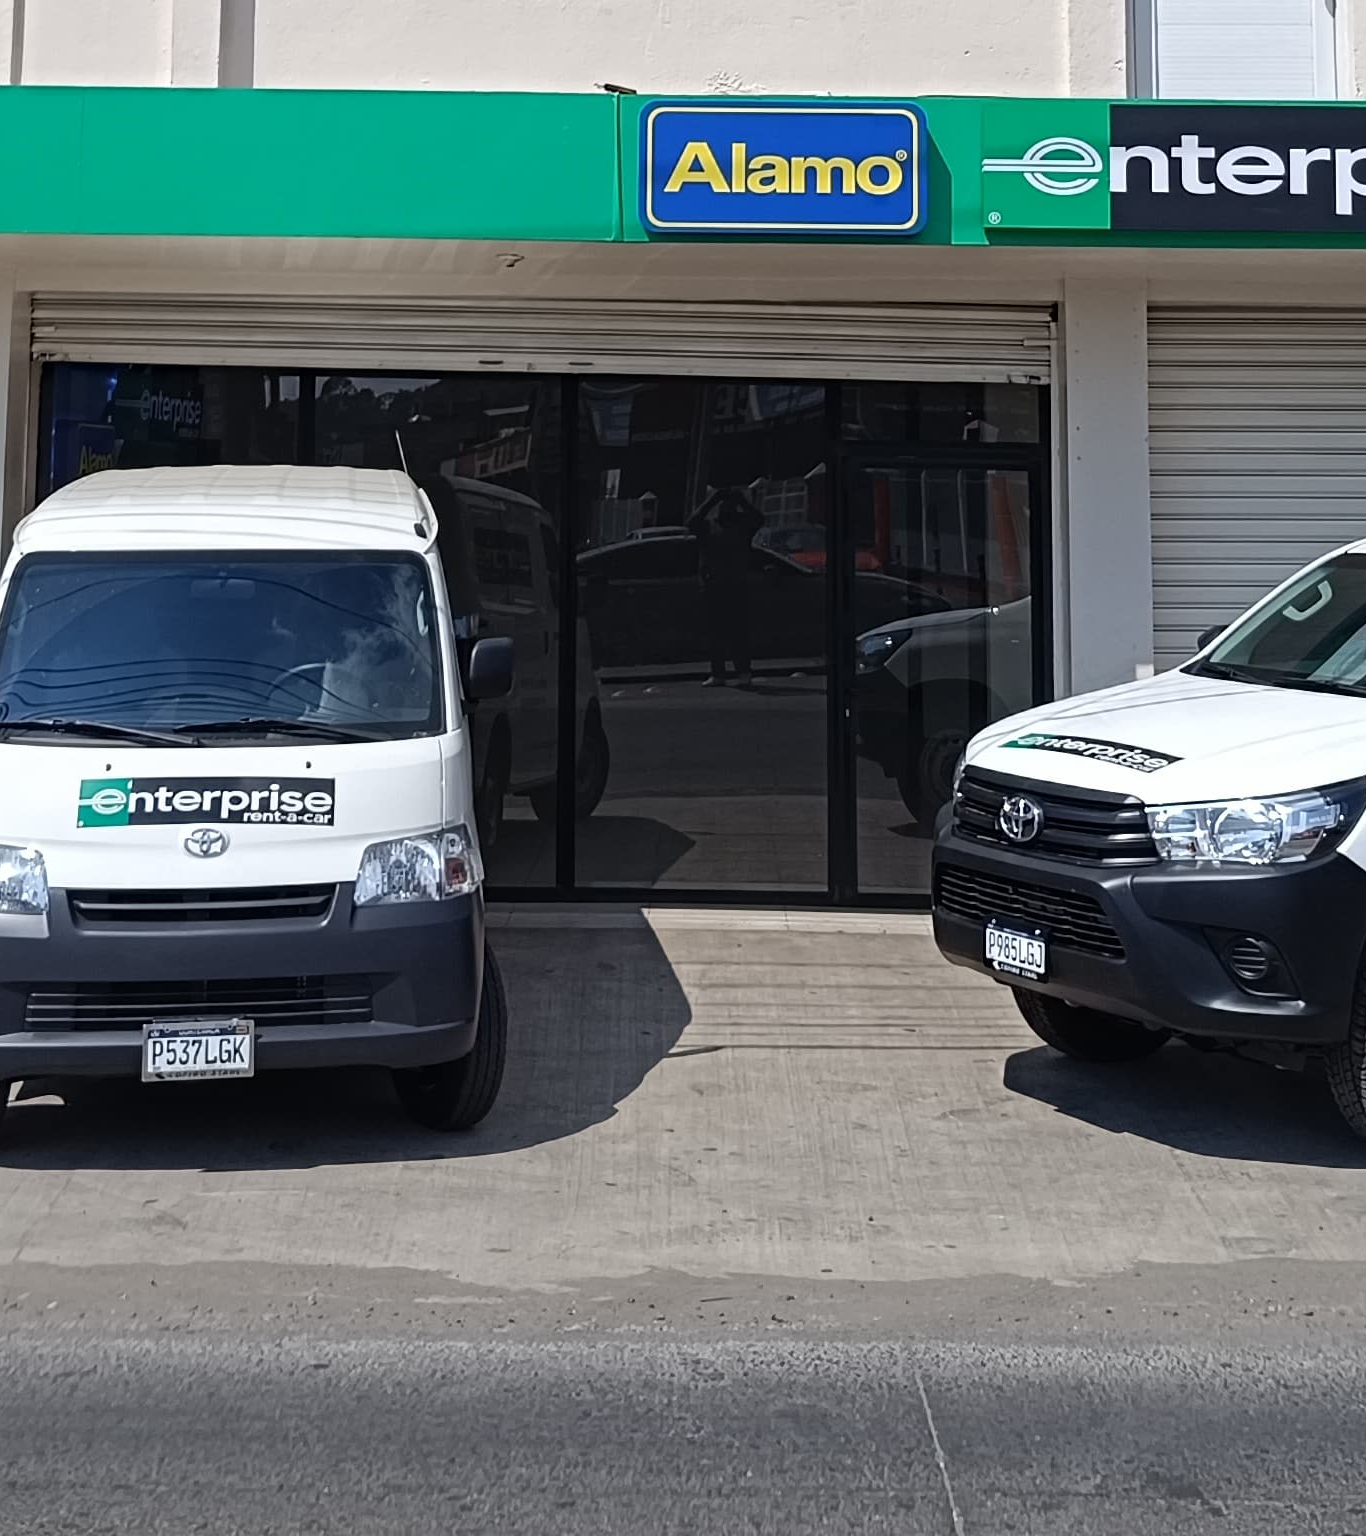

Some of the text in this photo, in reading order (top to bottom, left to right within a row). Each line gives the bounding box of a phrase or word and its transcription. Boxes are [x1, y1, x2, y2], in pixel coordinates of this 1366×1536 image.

[663, 141, 903, 195] Alamo
[116, 389, 203, 432] enterprise
[1016, 736, 1169, 768] enterprise
[79, 784, 333, 819] enterprise
[243, 810, 332, 824] rent-a-car
[988, 931, 1043, 968] P985LGJ
[152, 1037, 246, 1065] P537LGK
